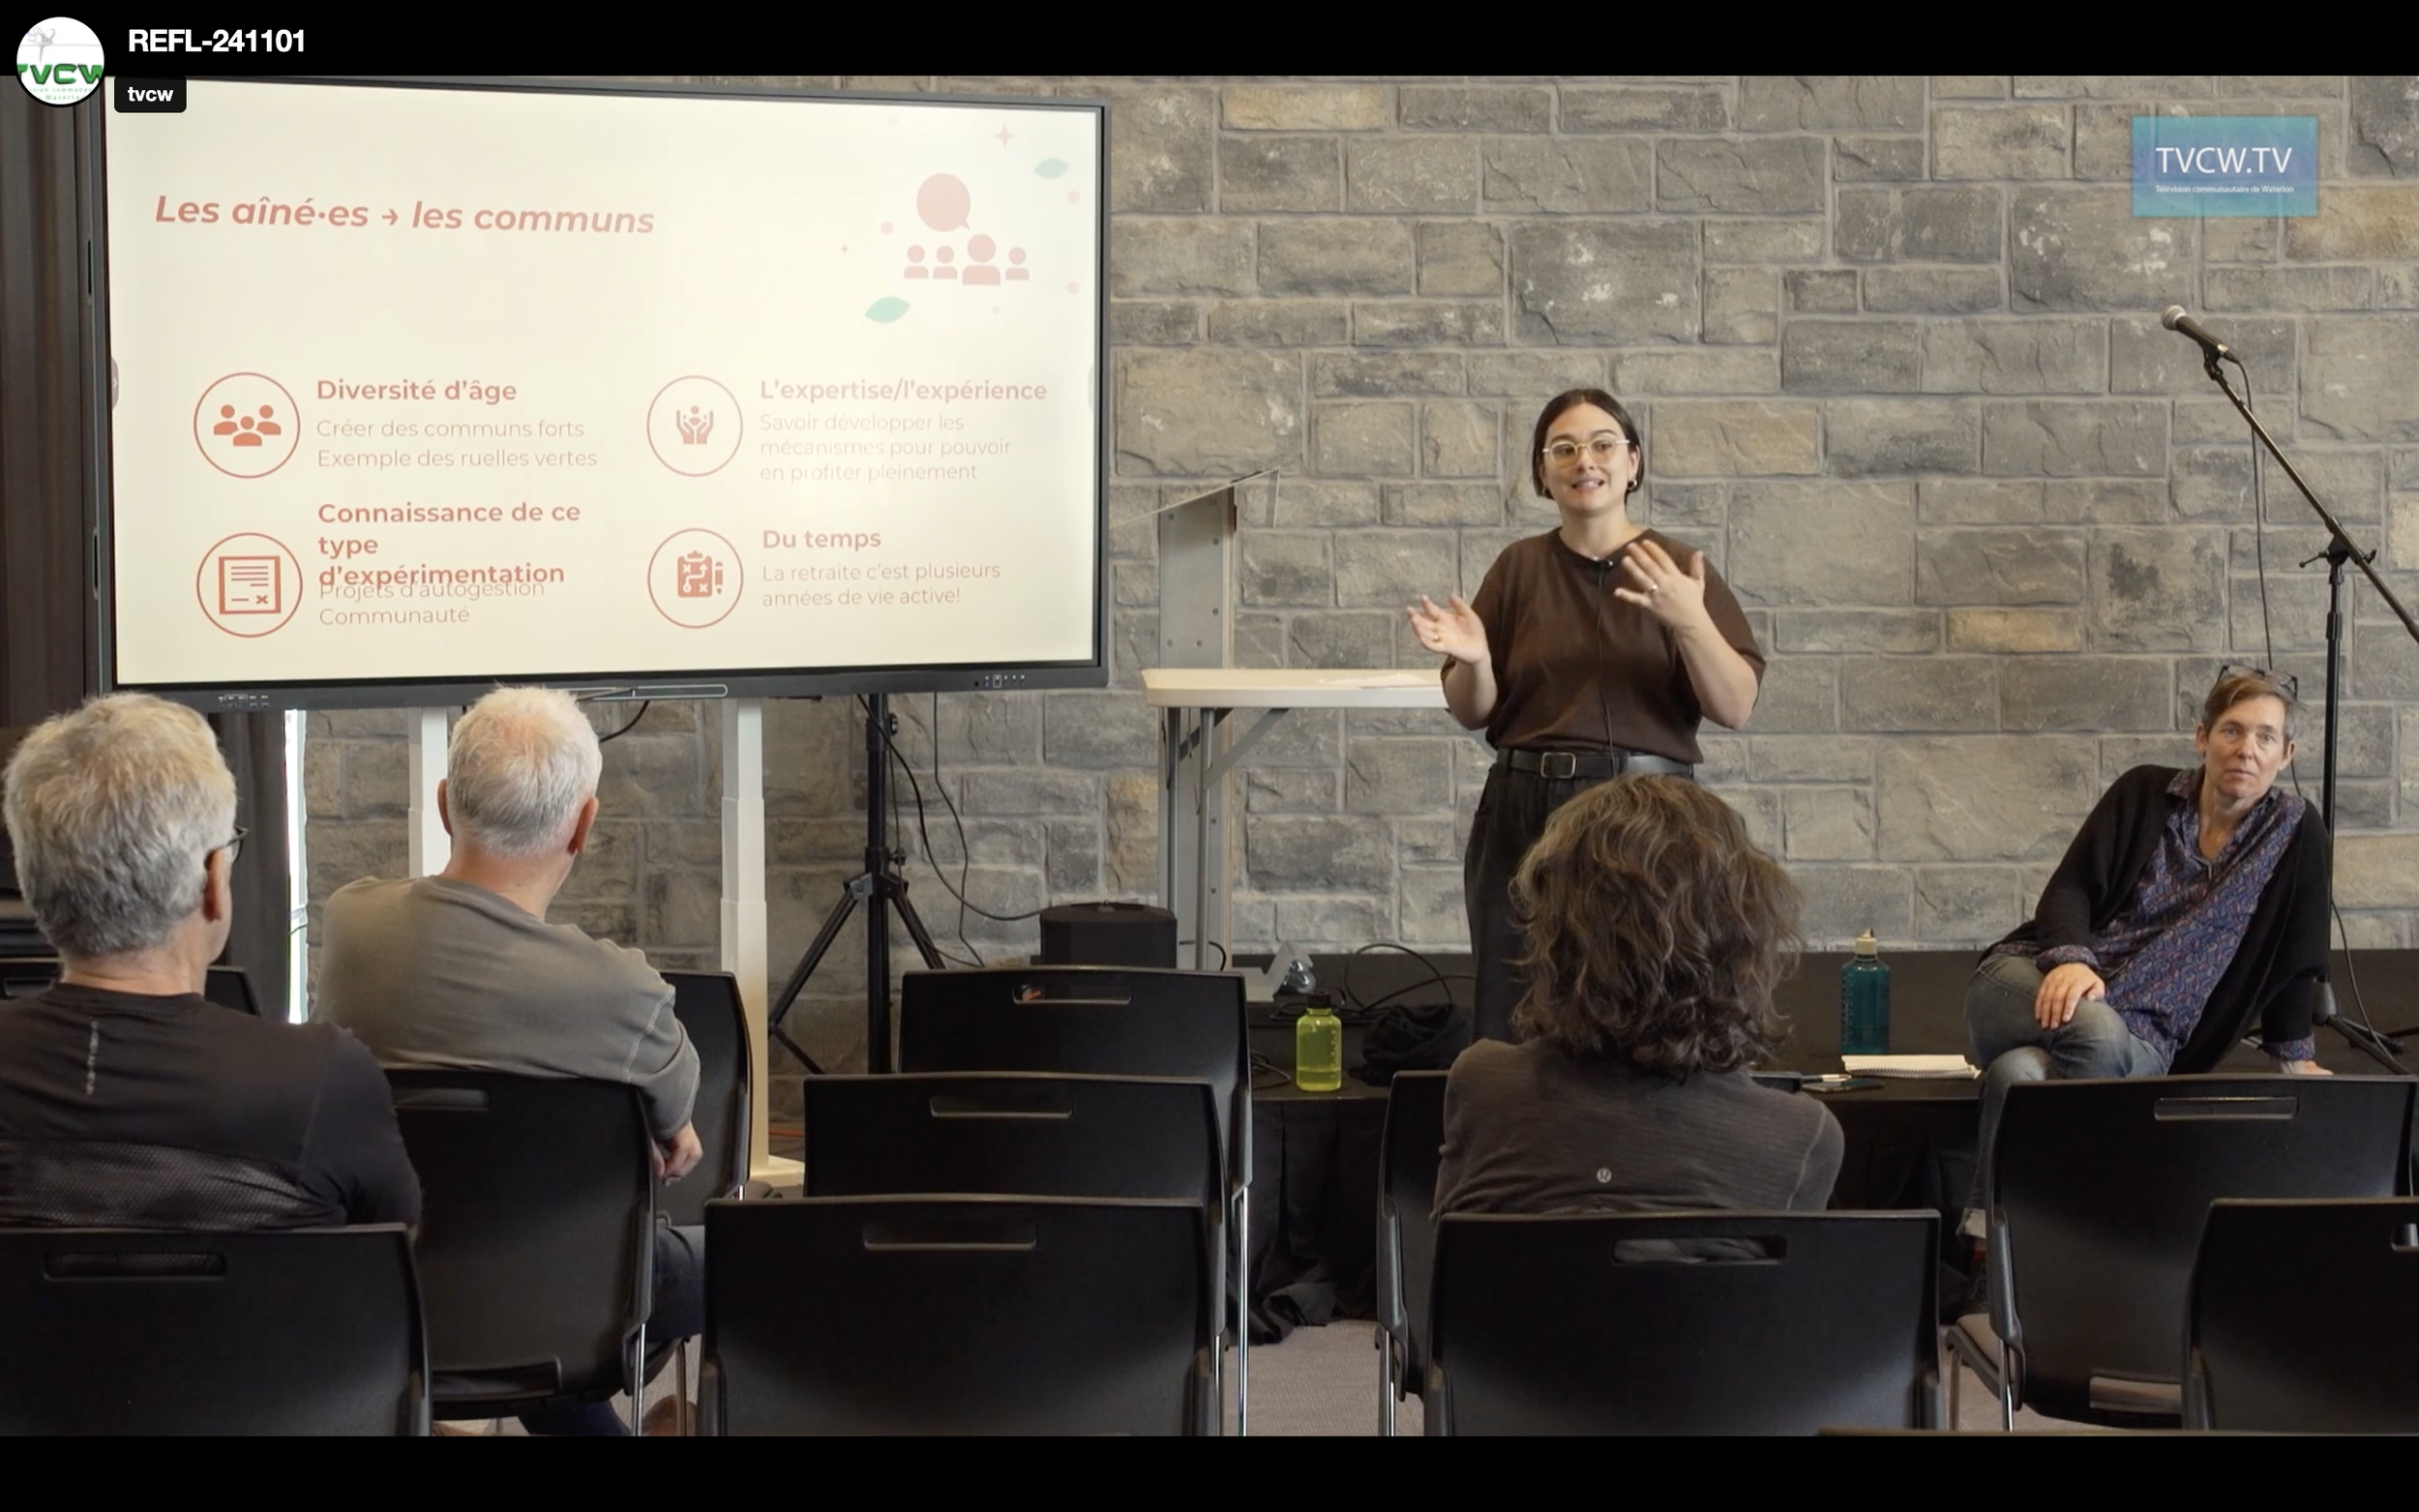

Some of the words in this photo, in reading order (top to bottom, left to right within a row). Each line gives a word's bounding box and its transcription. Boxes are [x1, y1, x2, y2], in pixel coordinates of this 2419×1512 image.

[156, 195, 220, 223] Les
[412, 201, 463, 228] les
[474, 210, 653, 233] communs
[317, 378, 435, 400] Diversité
[317, 420, 374, 436] Créer
[381, 419, 418, 436] des
[425, 424, 532, 436] communs
[538, 420, 584, 436] forts
[761, 413, 819, 430] Savoir
[824, 413, 932, 434] développer
[940, 414, 964, 430] les
[761, 438, 883, 455] mécanismes
[890, 442, 934, 459] pour
[941, 438, 1011, 458] pouvoir
[318, 450, 410, 470] Exemple
[418, 449, 454, 466] des
[462, 449, 529, 466] ruelles
[535, 451, 597, 466] vertes
[761, 468, 784, 481] en
[791, 463, 861, 484] profiter
[869, 463, 977, 484] pleinement
[318, 501, 503, 522] Connaissance
[512, 502, 543, 521] de
[552, 507, 581, 521] ce
[318, 537, 378, 559] type
[763, 530, 797, 548] Du
[805, 531, 881, 551] temps
[763, 565, 784, 581] La
[791, 564, 861, 580] retraite
[916, 562, 1000, 582] plusieurs
[762, 590, 832, 607] années
[838, 589, 862, 605] de
[868, 588, 894, 605] vie
[900, 587, 959, 604] active!
[319, 607, 469, 625] Communauté
